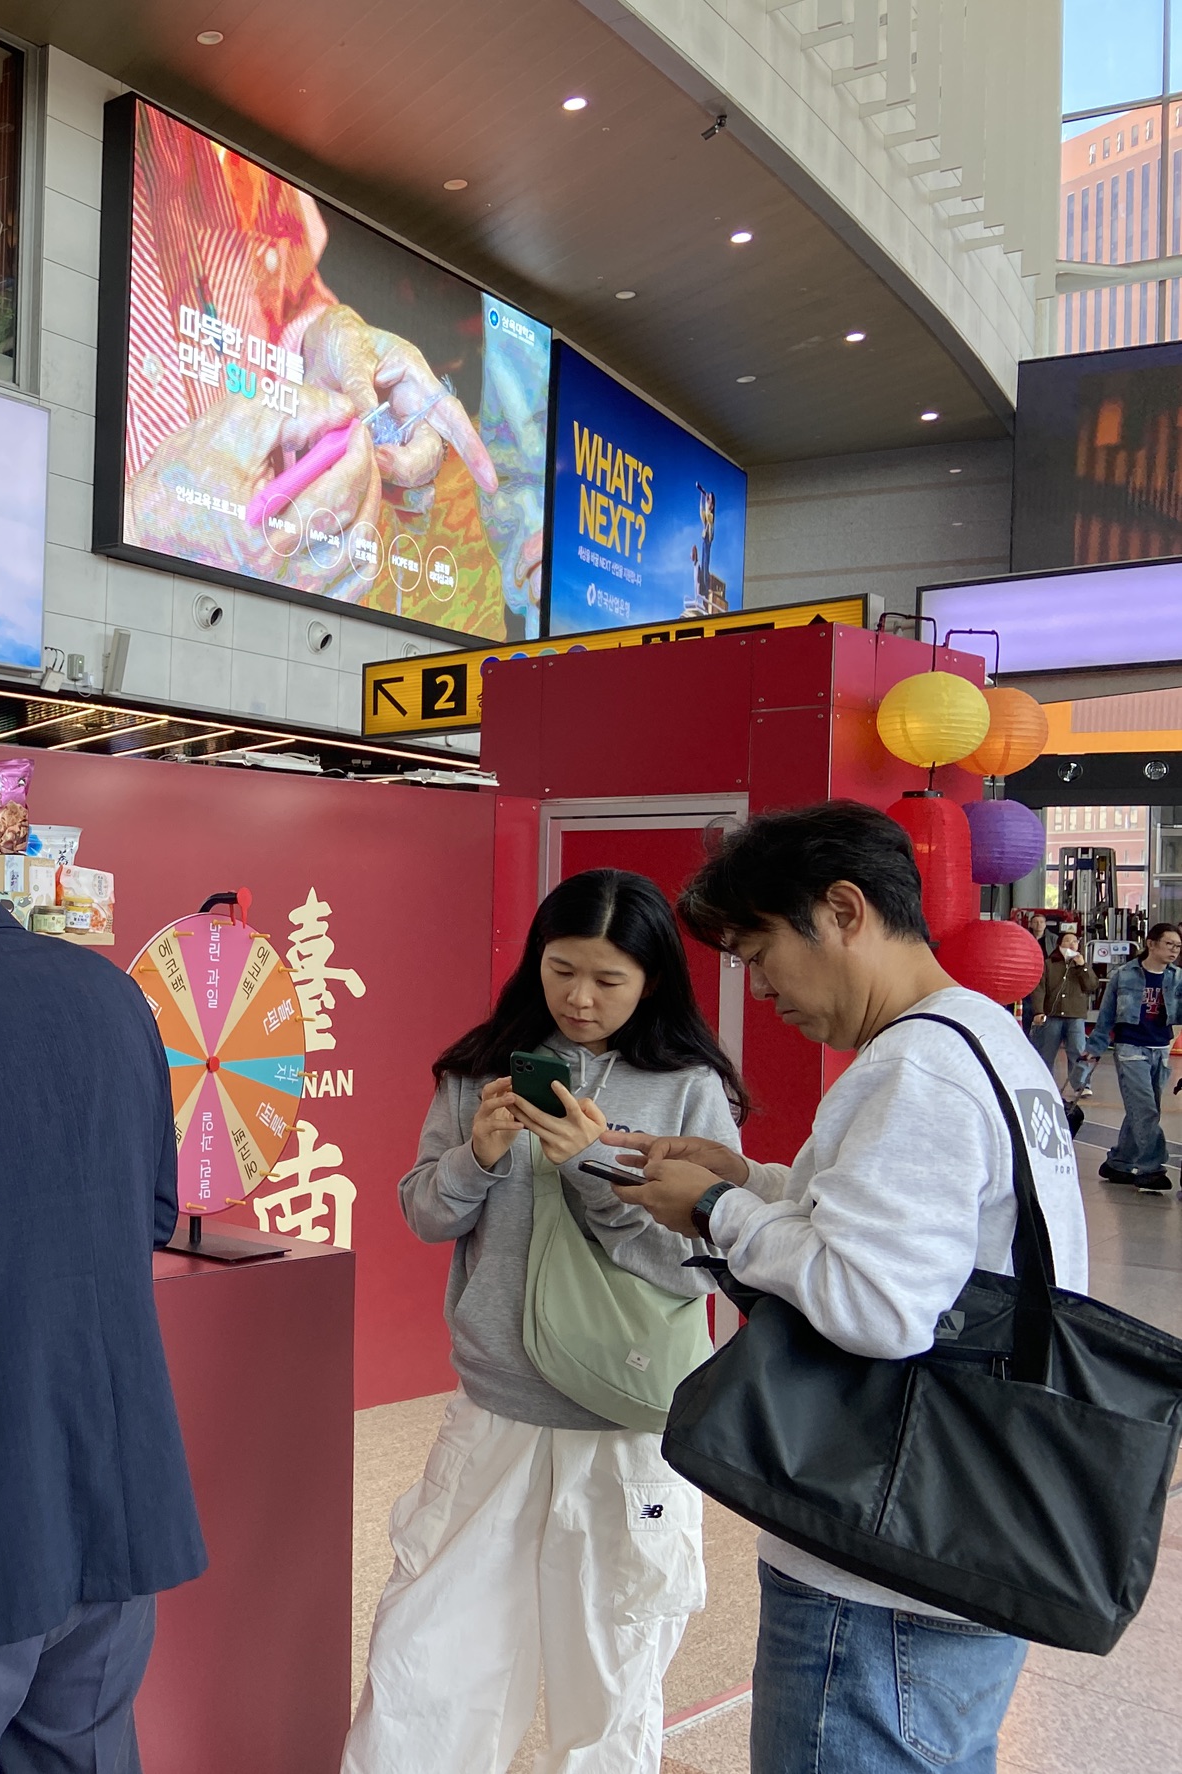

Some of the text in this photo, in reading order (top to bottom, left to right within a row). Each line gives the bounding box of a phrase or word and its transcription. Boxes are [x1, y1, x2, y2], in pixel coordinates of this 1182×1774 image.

[179, 304, 304, 386] 따뜻한 미래를
[178, 341, 299, 418] 만날 SU 있다
[573, 420, 653, 515] WHAT'S
[211, 496, 246, 520] 프로그램
[579, 483, 646, 563] NEXT?
[392, 554, 408, 570] HOPE
[599, 556, 611, 572] NEXT
[597, 588, 630, 619] 한국산업은행
[434, 674, 456, 710] 2
[158, 937, 187, 993] 에코백
[242, 946, 271, 1000] 에코백
[206, 968, 220, 1009] 과일
[262, 997, 295, 1036] 볼펜
[274, 1063, 300, 1084] 과자
[302, 1069, 354, 1099] NAN
[255, 1101, 288, 1139] 볼펜
[198, 1111, 214, 1200] 말린 과일
[231, 1128, 258, 1180] 에코백
